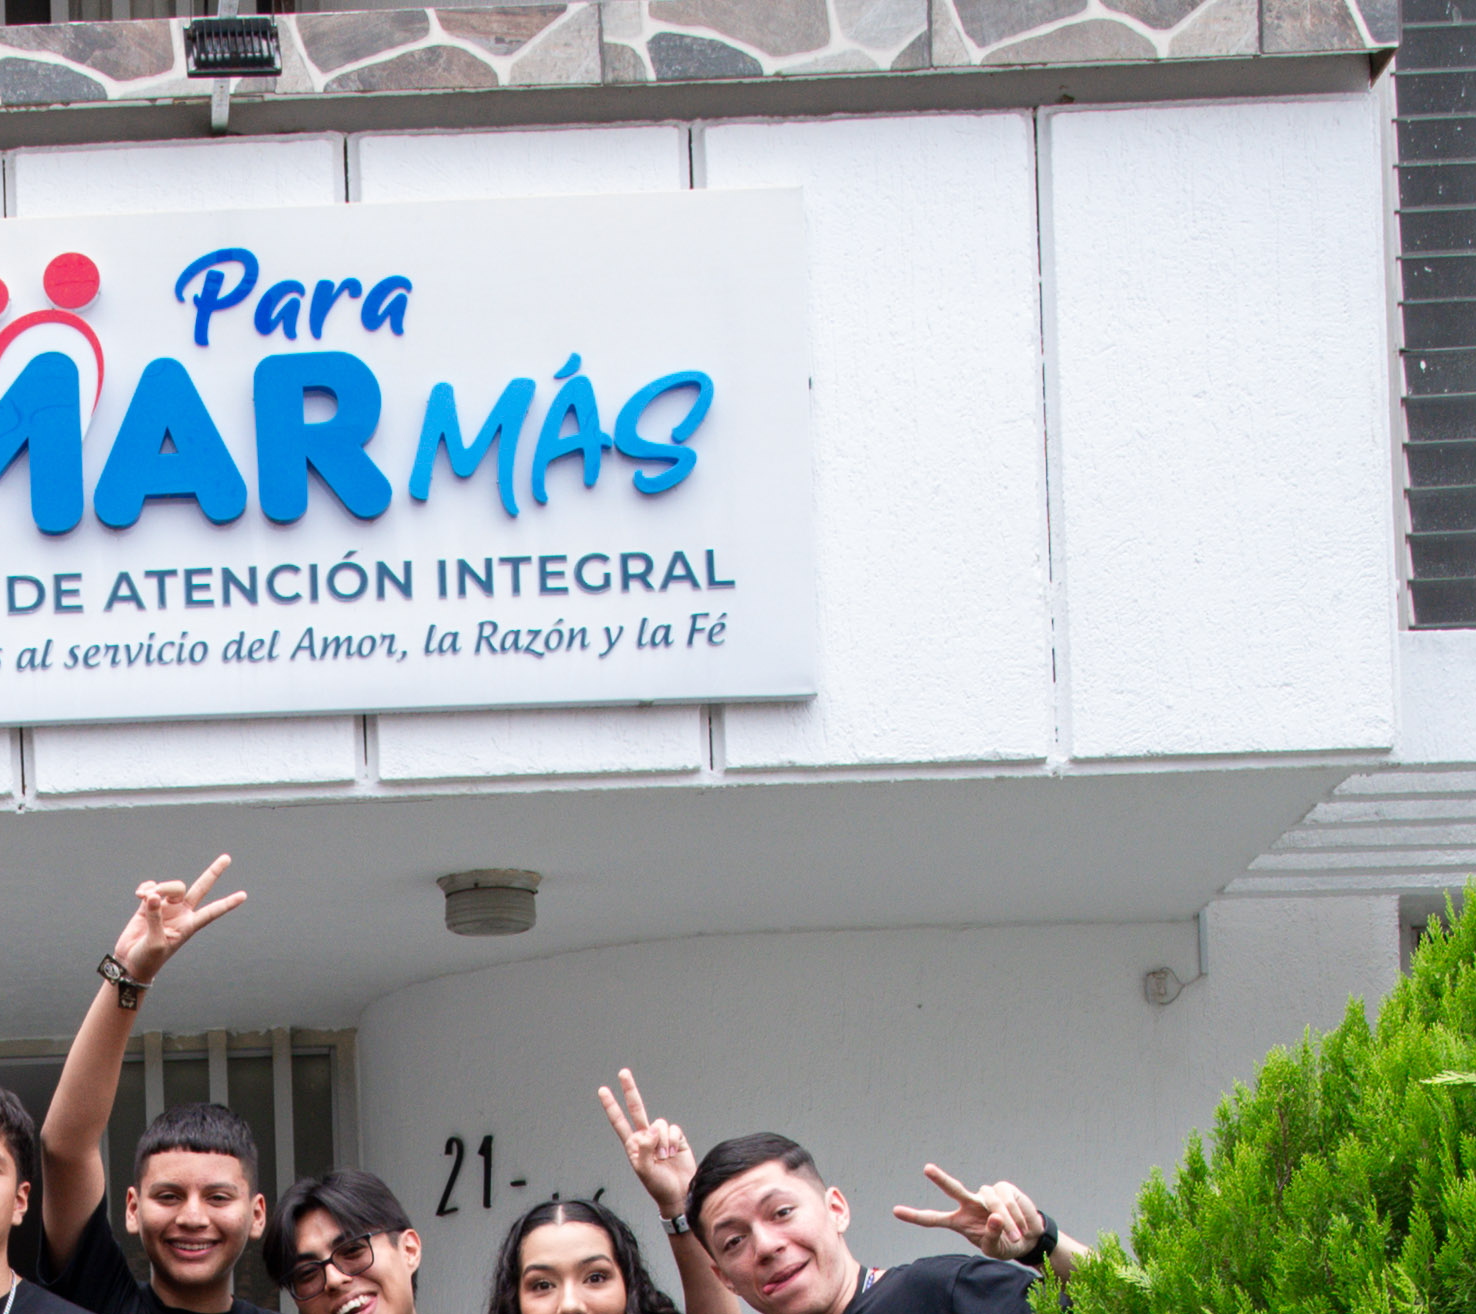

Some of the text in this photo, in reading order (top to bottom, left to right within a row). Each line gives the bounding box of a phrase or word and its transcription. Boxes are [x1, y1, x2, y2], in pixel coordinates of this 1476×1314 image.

[173, 247, 414, 347] Para
[409, 352, 715, 517] MÁS
[6, 571, 84, 617] DE
[103, 549, 413, 612] ATENCIÓN
[437, 548, 736, 599] INTEGRAL
[15, 639, 54, 672] al
[62, 631, 209, 670] servicio
[220, 629, 280, 664] del
[288, 626, 409, 664] Amor,
[423, 624, 462, 657] la
[473, 618, 590, 659] Razón
[598, 626, 624, 659] y
[635, 616, 675, 650] la
[686, 612, 728, 648] Fé
